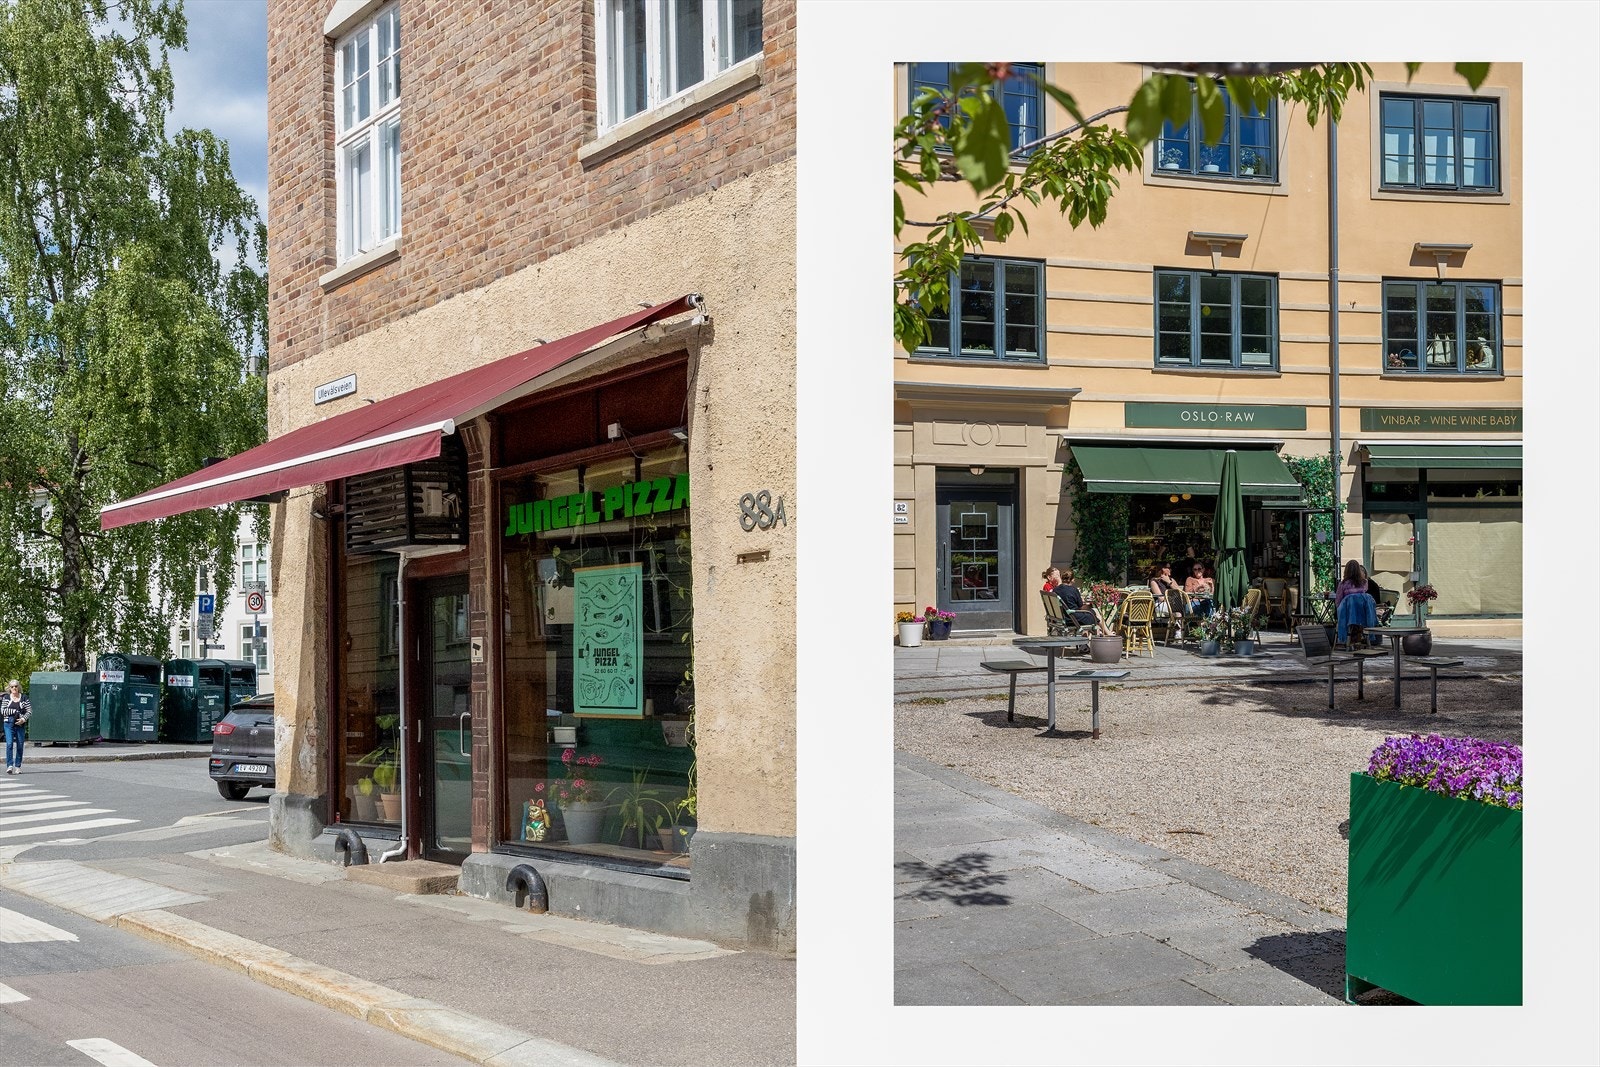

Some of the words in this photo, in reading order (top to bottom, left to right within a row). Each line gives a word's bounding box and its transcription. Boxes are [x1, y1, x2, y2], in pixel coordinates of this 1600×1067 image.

[1381, 415, 1420, 425] VINBAR
[1430, 415, 1457, 425] WINE
[1460, 415, 1487, 425] WINE
[1489, 415, 1517, 426] BABY
[505, 492, 600, 537] JUNGEL
[604, 473, 690, 521] PIZZA
[896, 503, 906, 512] 82
[201, 597, 211, 612] P
[250, 597, 261, 606] 30
[593, 647, 620, 657] JUNGEL
[594, 657, 618, 666] PIZZA
